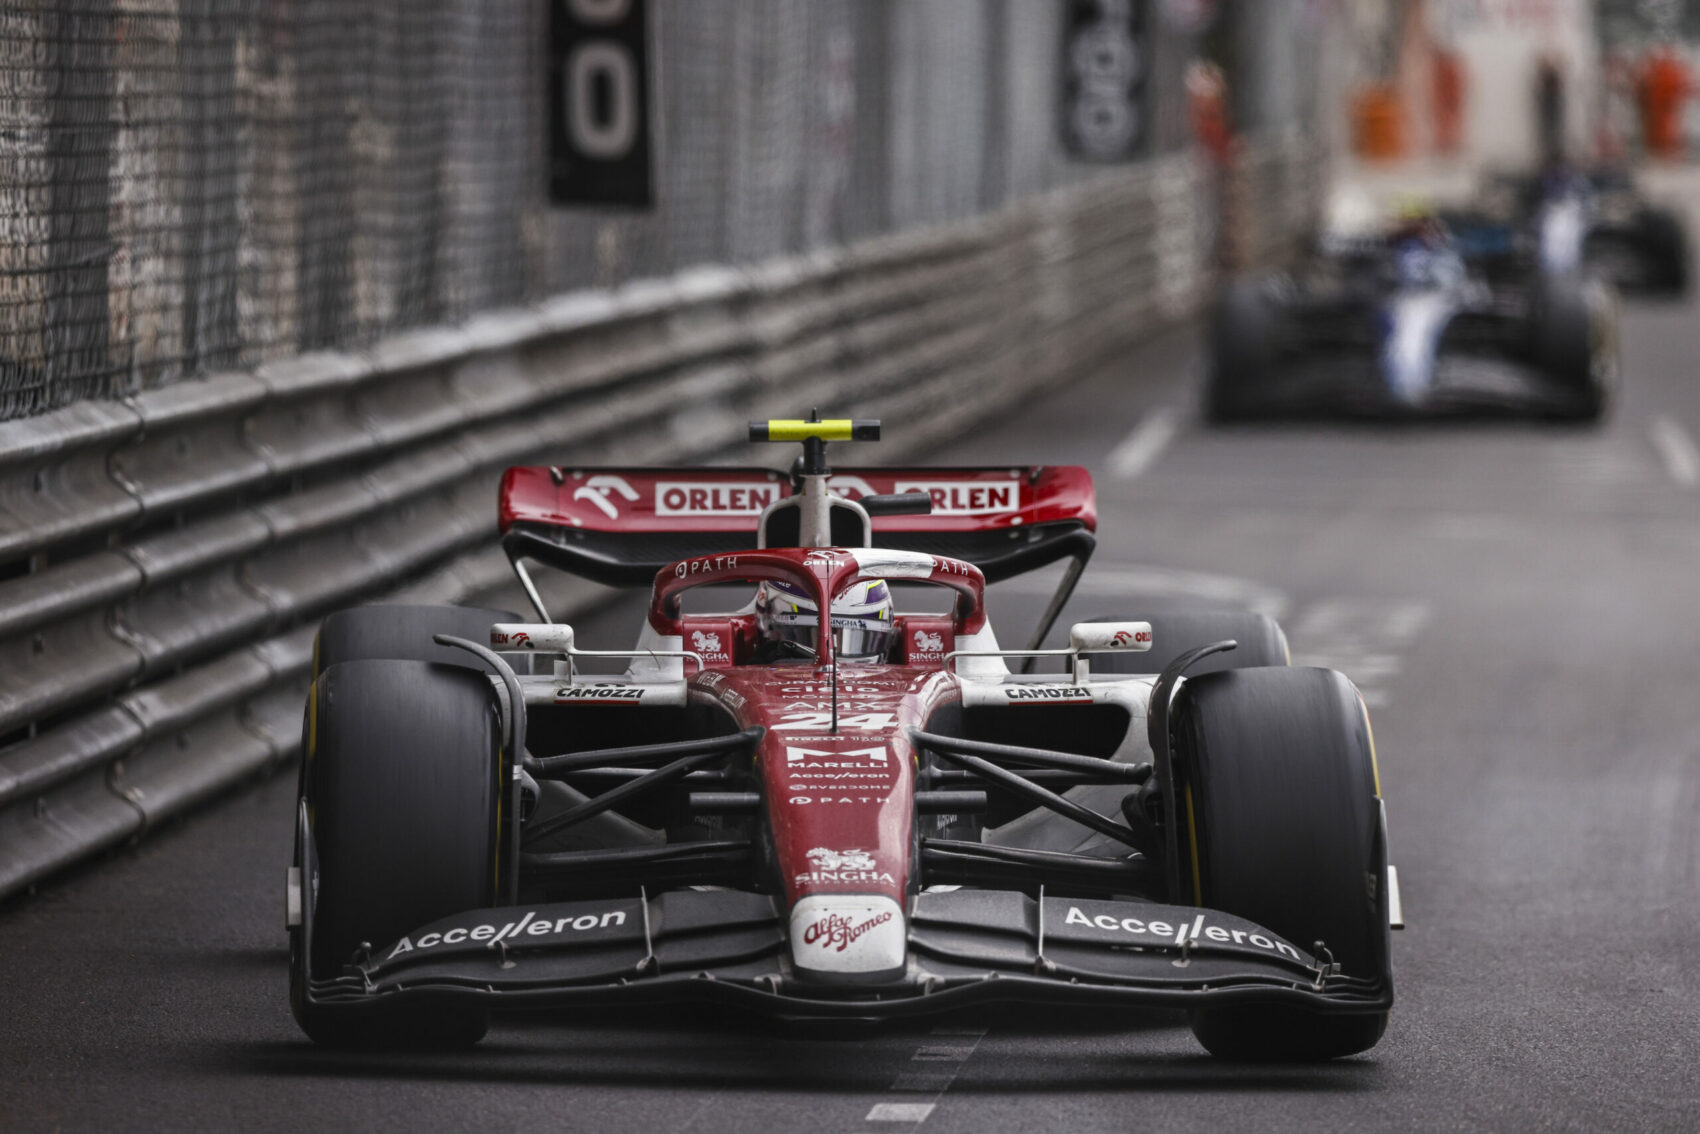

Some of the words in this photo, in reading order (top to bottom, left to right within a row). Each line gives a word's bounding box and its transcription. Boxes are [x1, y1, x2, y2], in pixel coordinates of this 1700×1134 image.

[664, 487, 771, 510] ORLEN
[691, 557, 737, 574] PATH
[556, 688, 645, 699] CAMOZZI
[1005, 688, 1091, 699] CAMOZZI
[784, 702, 881, 710] AMX
[769, 713, 899, 730] 24
[794, 871, 896, 883] SINGHA
[387, 911, 627, 960] Accelleron
[1065, 906, 1301, 960] Accelleron
